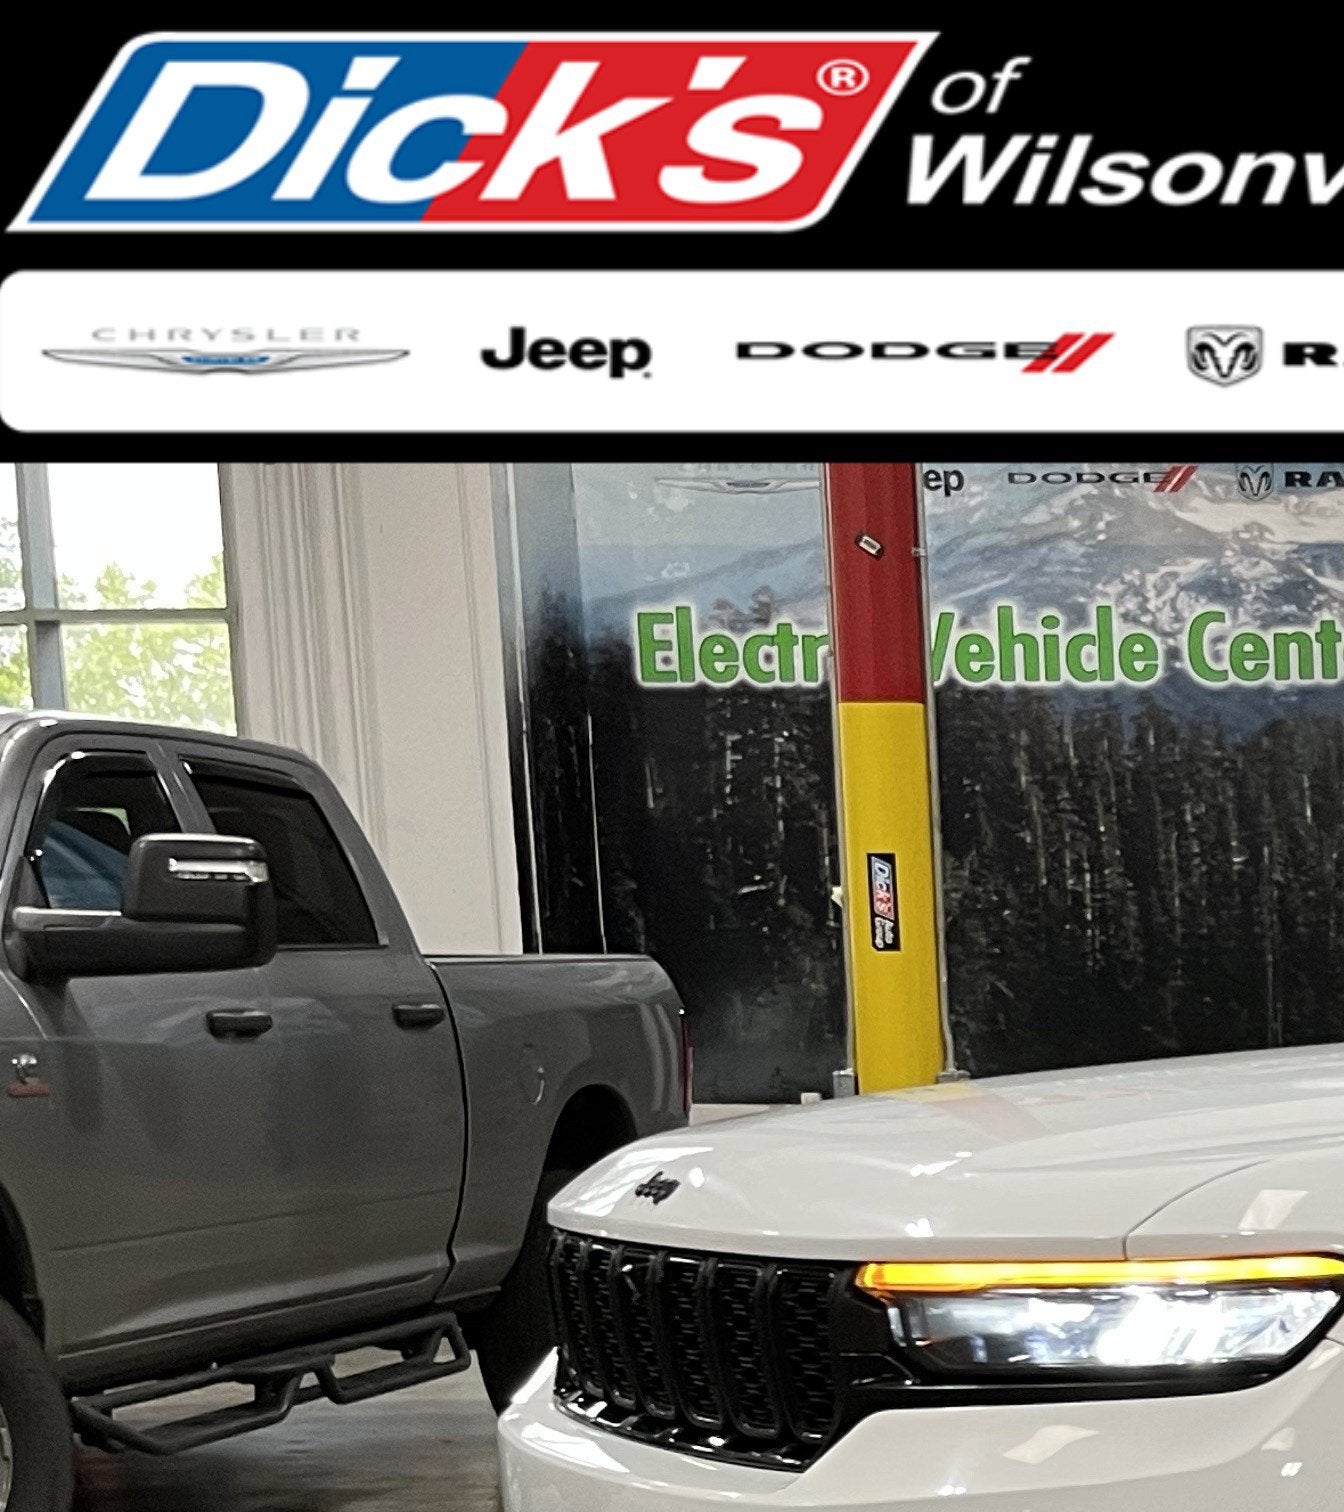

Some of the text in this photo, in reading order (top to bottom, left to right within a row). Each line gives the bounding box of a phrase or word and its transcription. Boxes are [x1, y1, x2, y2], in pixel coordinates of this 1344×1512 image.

[923, 467, 965, 497] ep
[1008, 471, 1168, 486] DODGE
[636, 605, 830, 684] Electr
